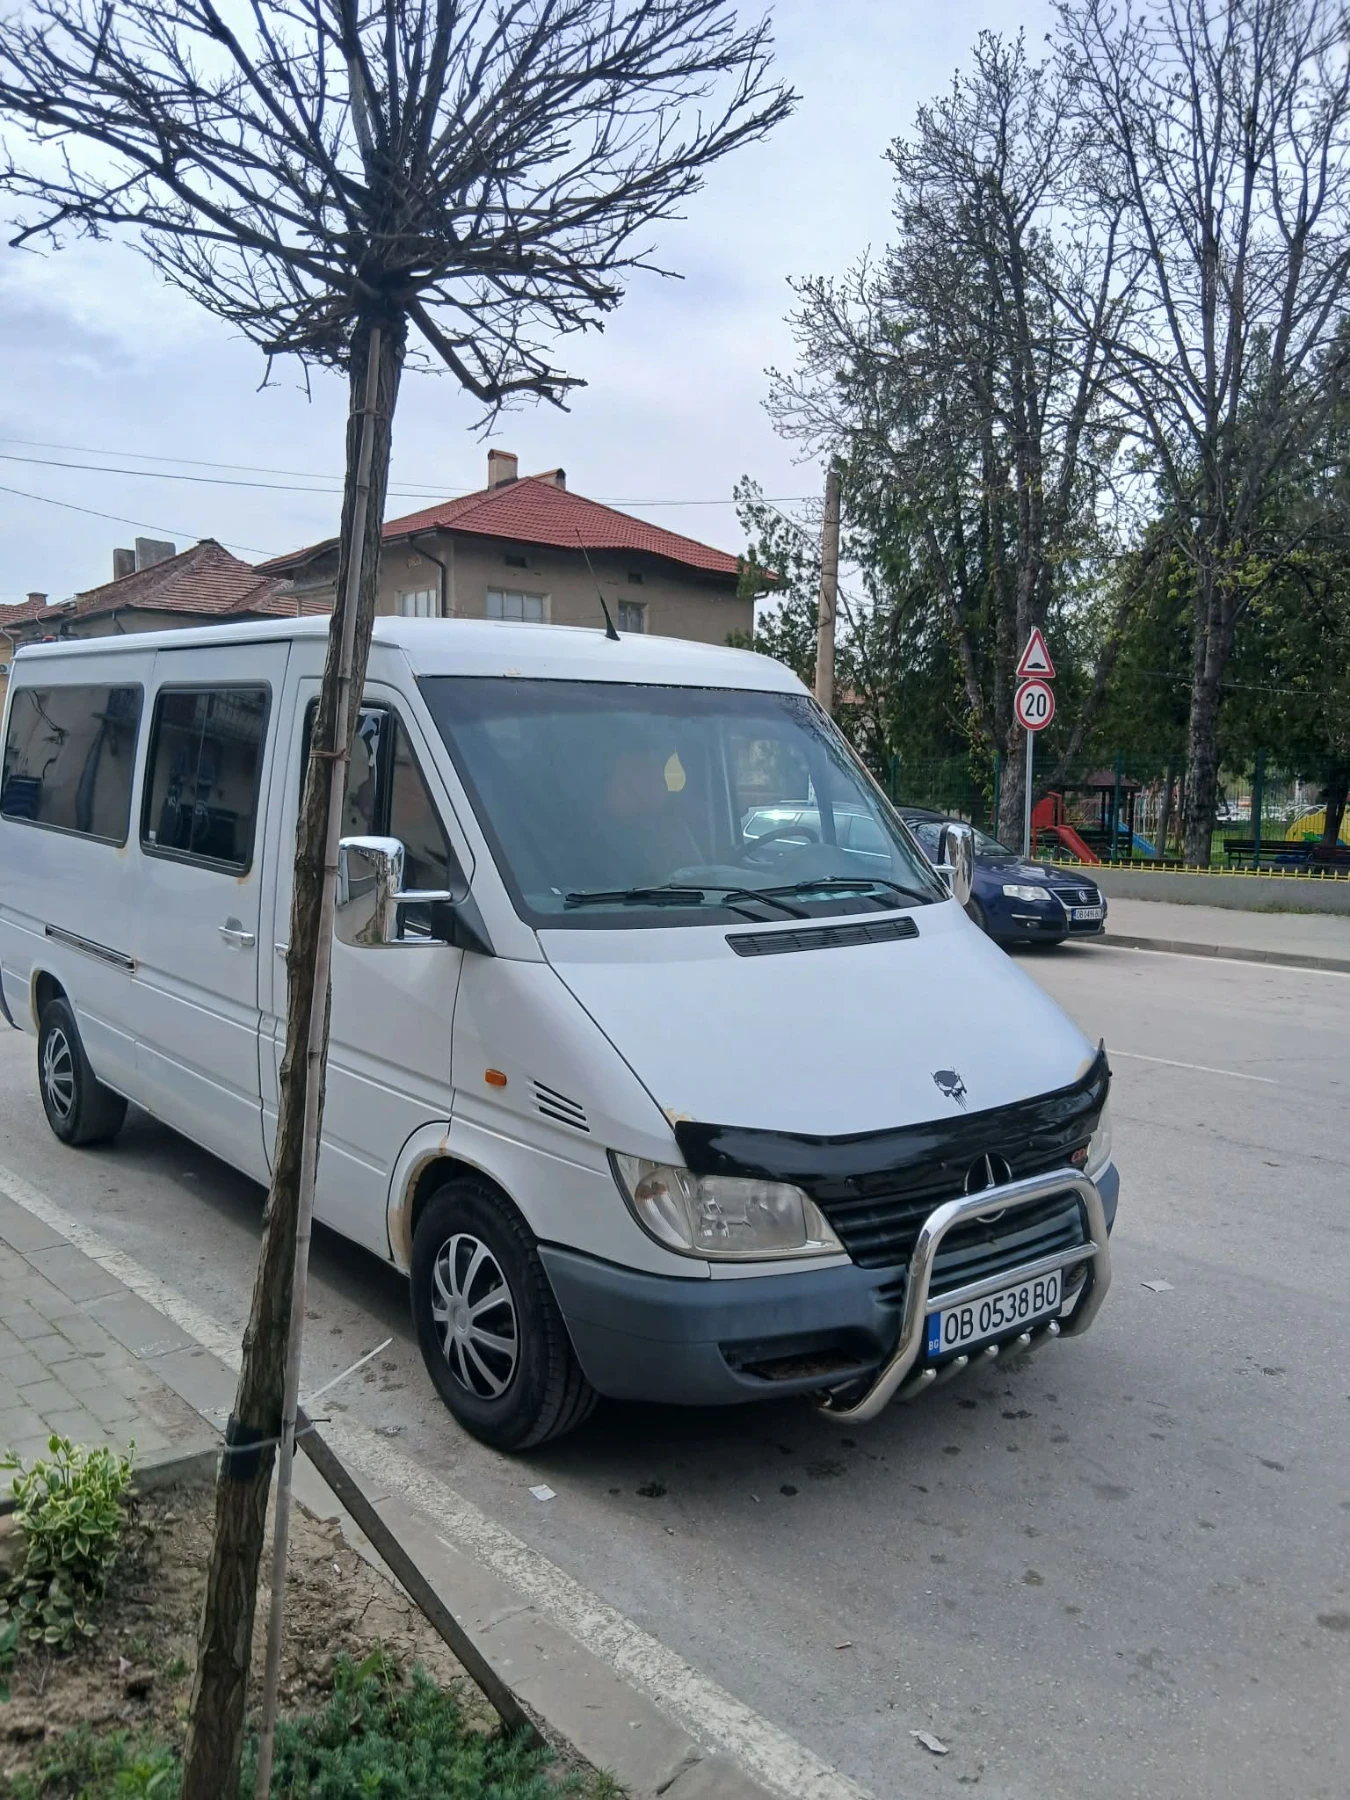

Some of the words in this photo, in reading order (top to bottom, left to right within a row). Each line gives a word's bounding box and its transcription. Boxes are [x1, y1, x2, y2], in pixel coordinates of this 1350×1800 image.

[1025, 692, 1047, 717] 20
[944, 1307, 974, 1345] OB
[979, 1287, 1029, 1332] 0538
[1033, 1276, 1057, 1312] BO
[928, 1338, 939, 1351] BG
